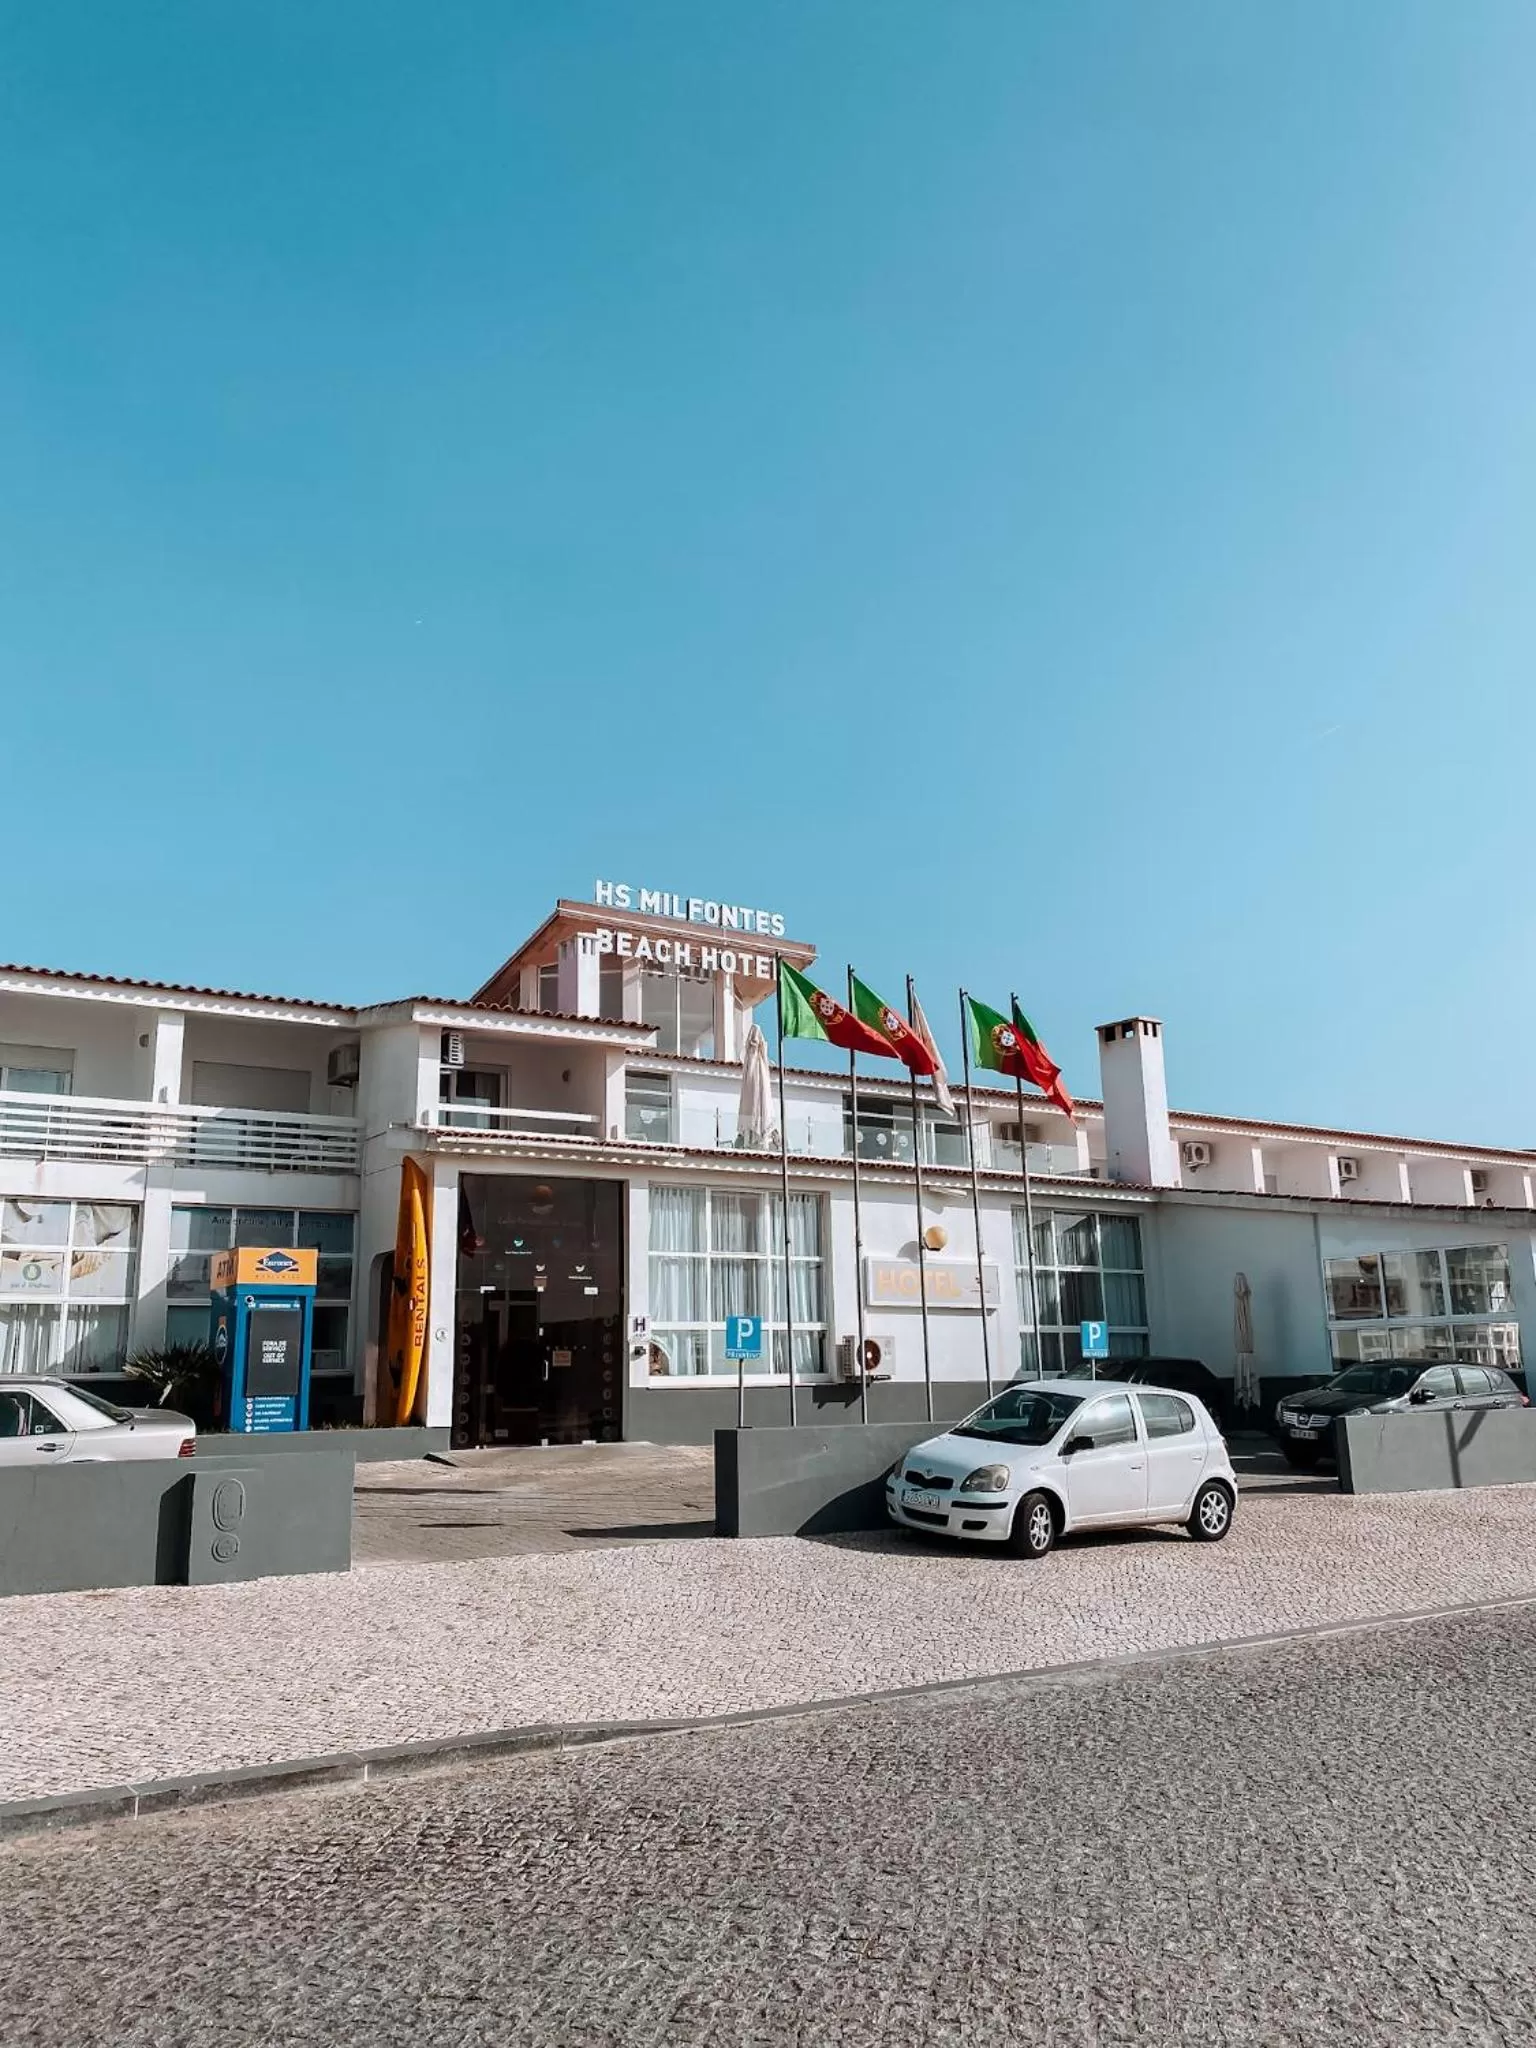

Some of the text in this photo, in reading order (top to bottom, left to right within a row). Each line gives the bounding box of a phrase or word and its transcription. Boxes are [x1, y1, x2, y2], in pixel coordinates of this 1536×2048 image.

[596, 880, 786, 937] HS MILFONTES
[596, 928, 691, 967] BEACH
[217, 1259, 234, 1279] ATM
[877, 1268, 961, 1297] HOTEL
[414, 1257, 425, 1347] RENTALS
[634, 1316, 646, 1332] H
[737, 1318, 754, 1349] P
[1089, 1321, 1101, 1348] P
